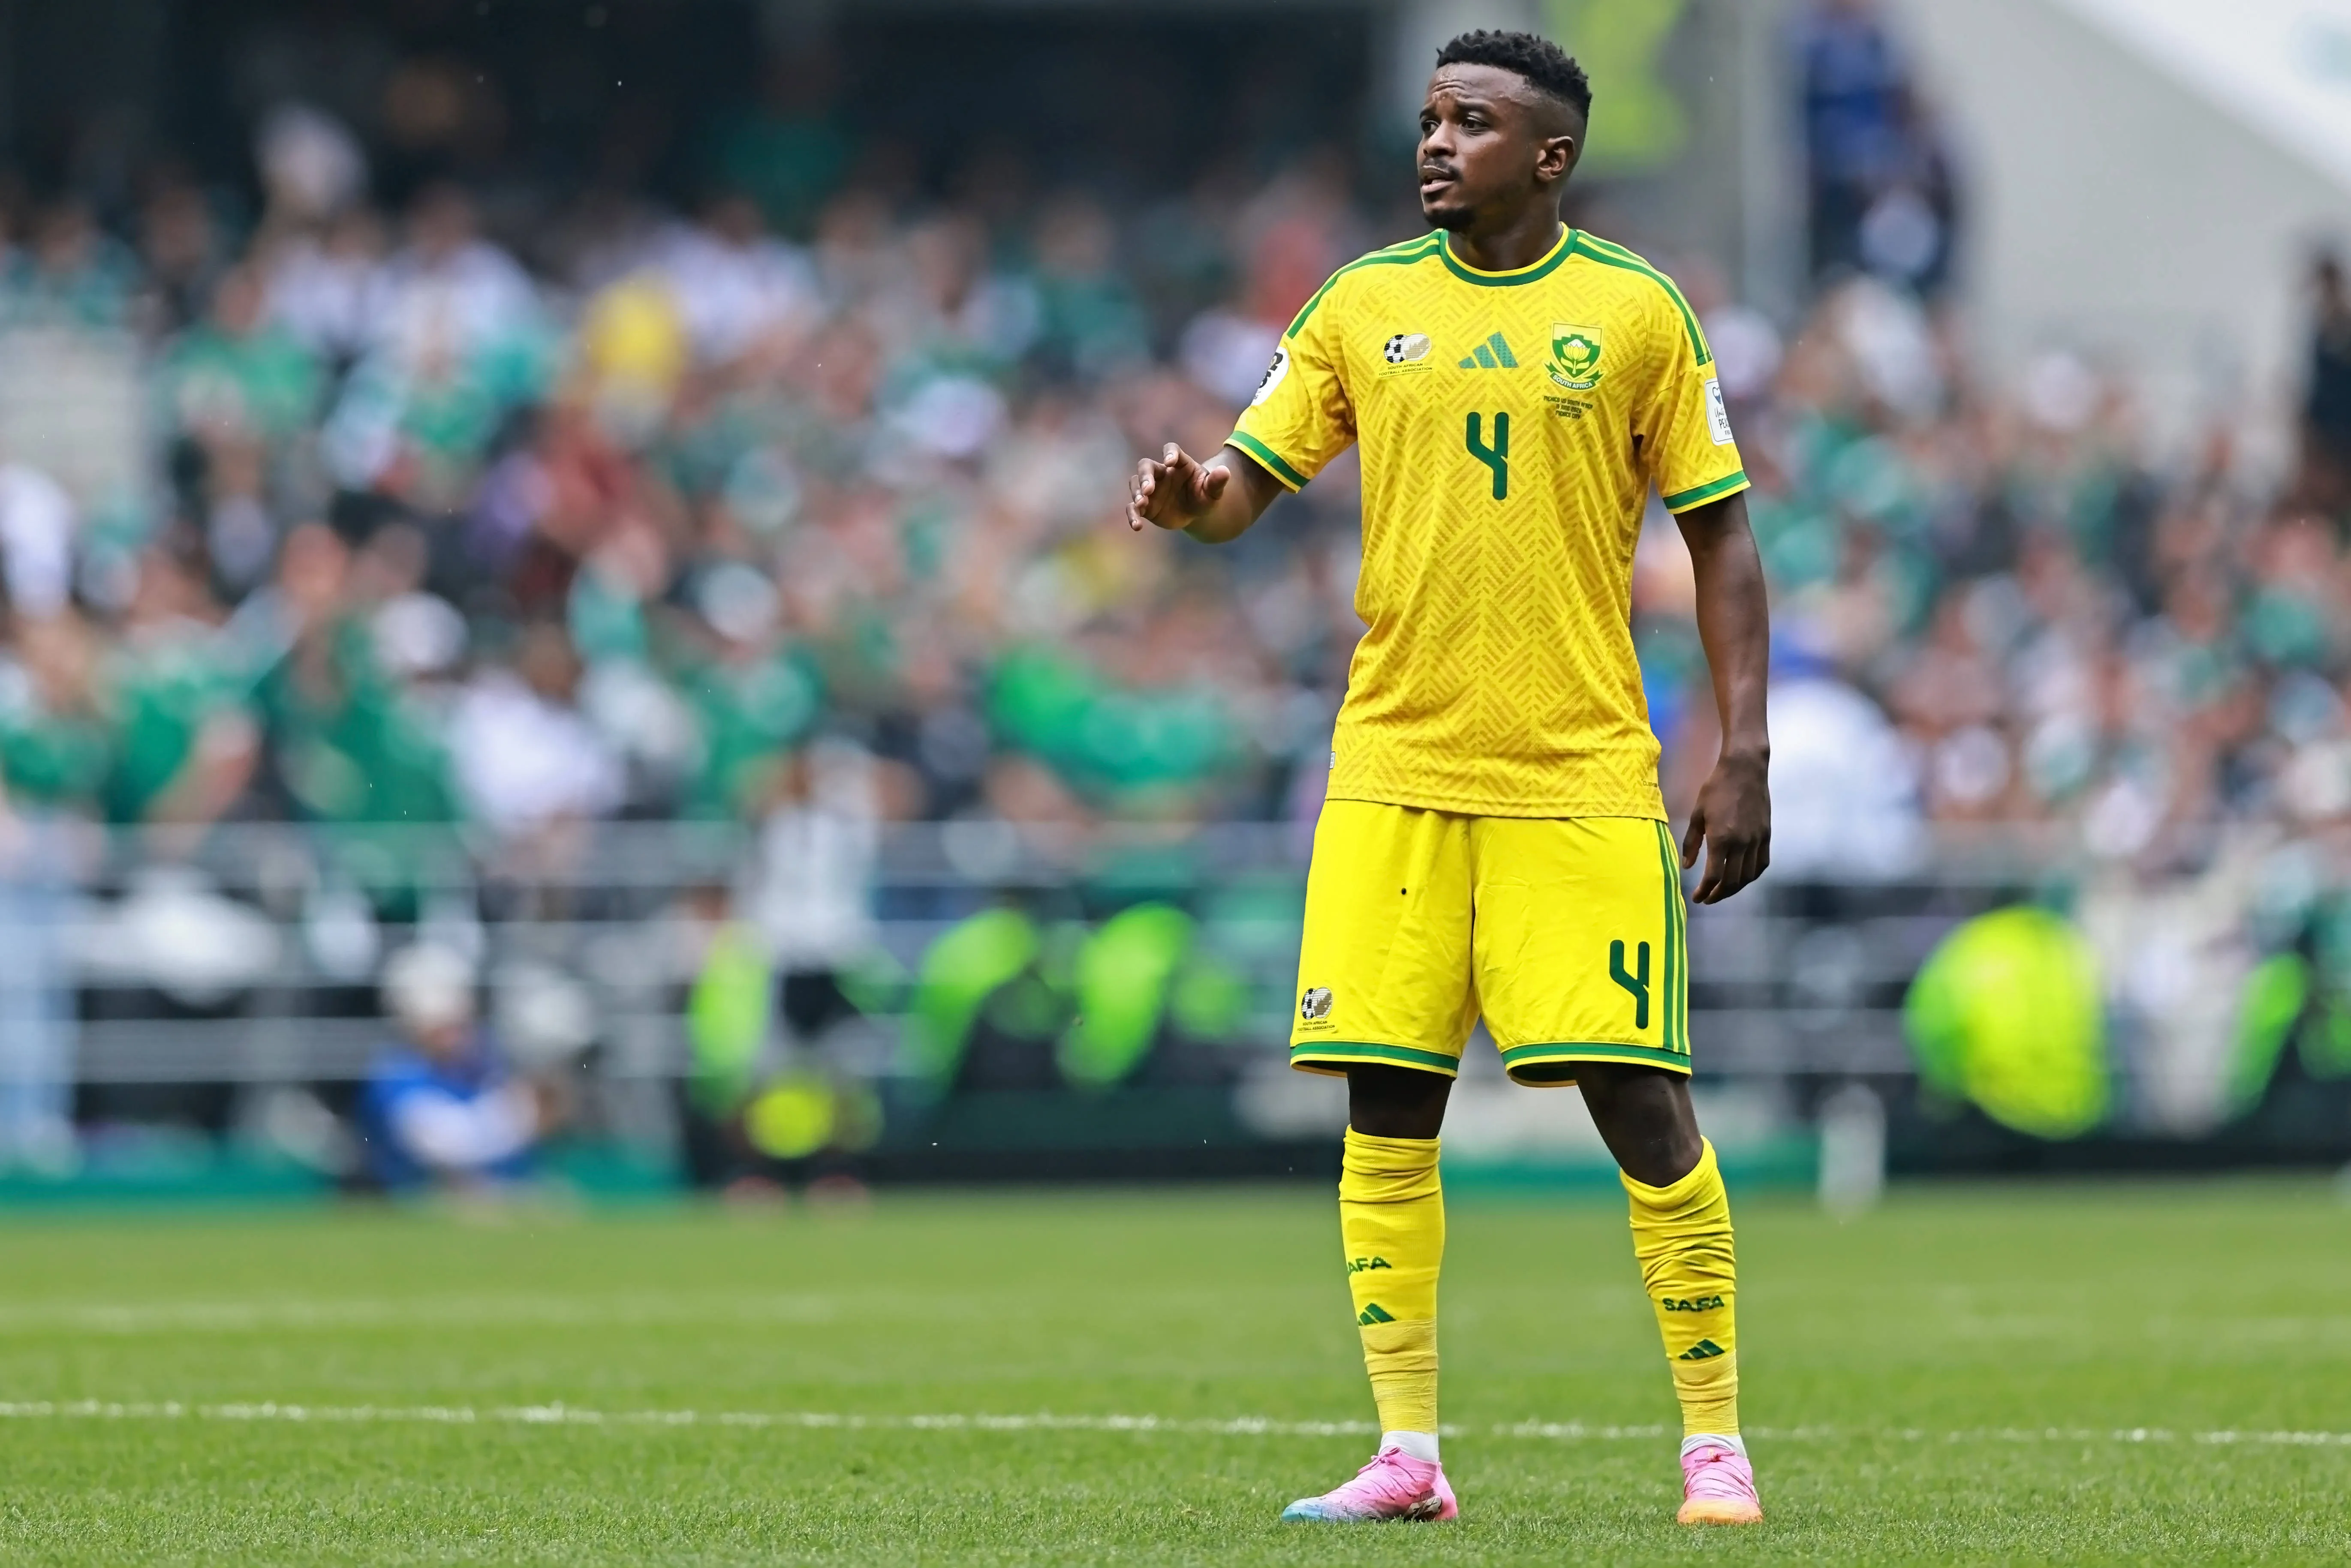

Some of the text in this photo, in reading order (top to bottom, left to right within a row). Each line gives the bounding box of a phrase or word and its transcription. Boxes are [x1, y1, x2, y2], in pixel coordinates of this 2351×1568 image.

[1553, 375, 1571, 387] SOUTH
[1466, 411, 1509, 500] 4
[1609, 939, 1650, 1029] 4
[1348, 1256, 1392, 1276] AFA
[1662, 1294, 1725, 1312] SAFA
